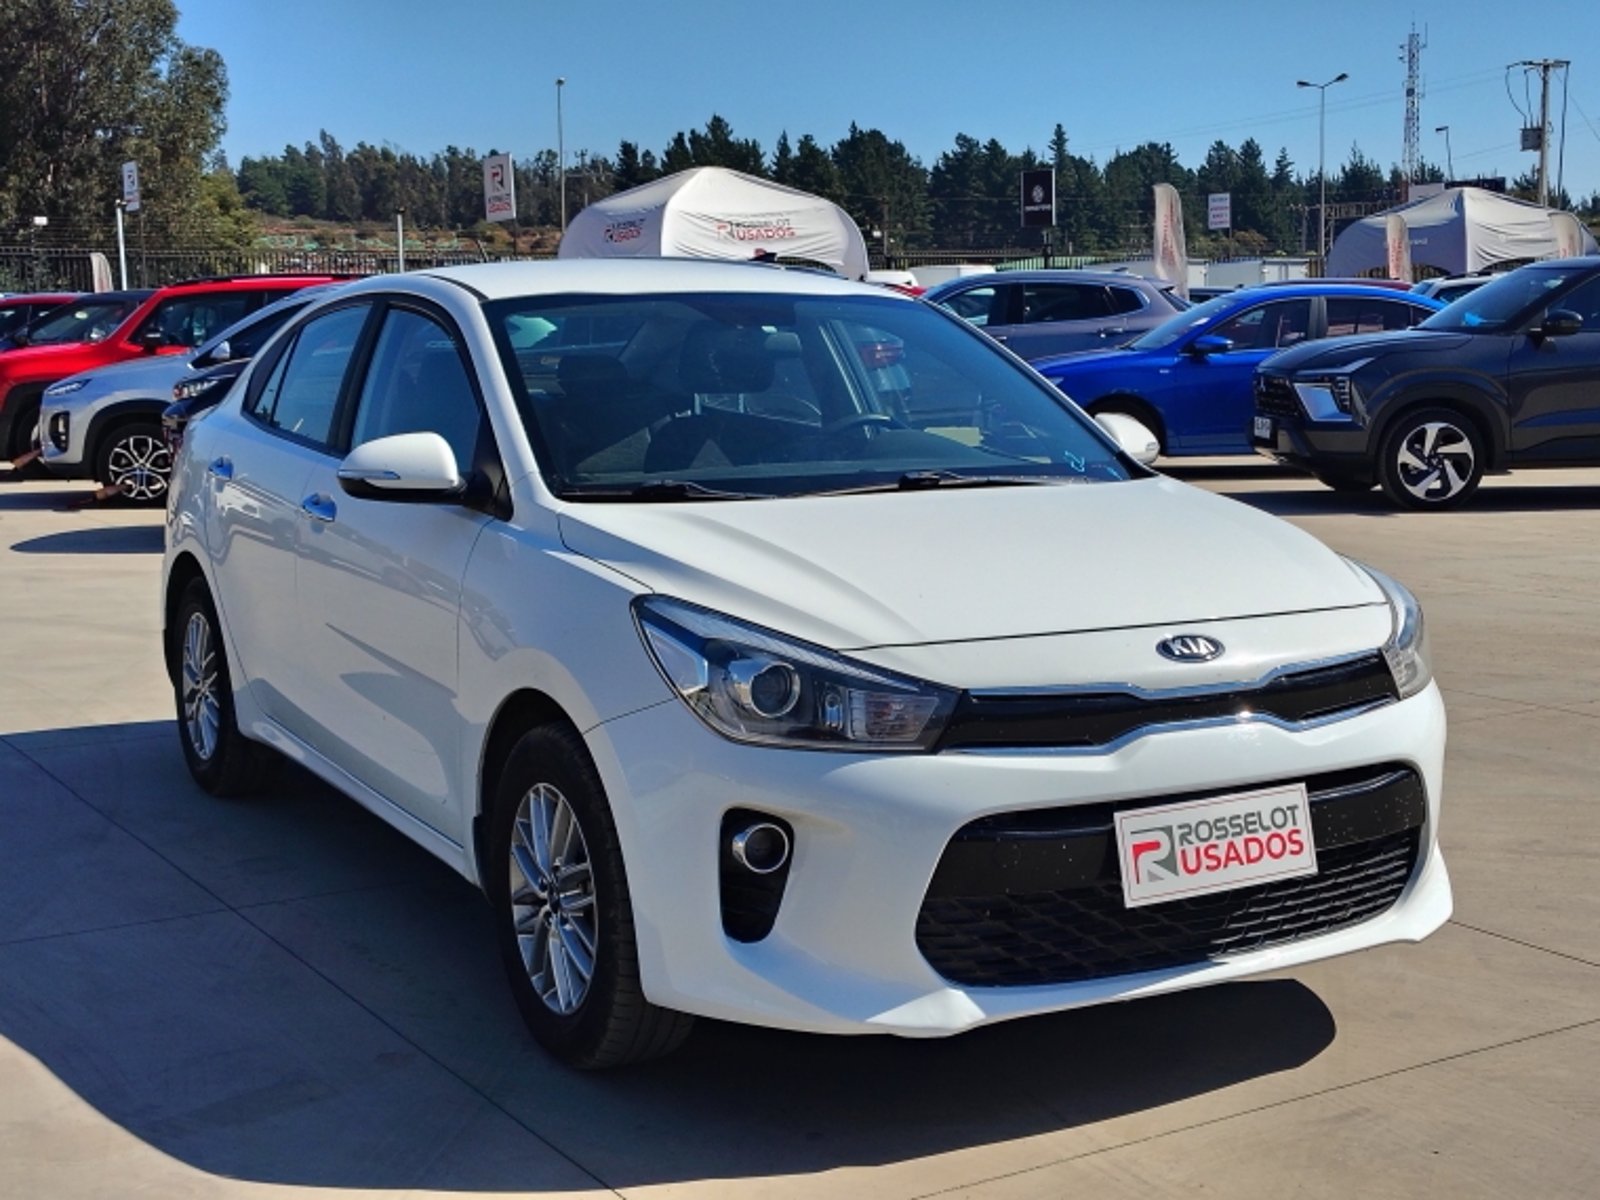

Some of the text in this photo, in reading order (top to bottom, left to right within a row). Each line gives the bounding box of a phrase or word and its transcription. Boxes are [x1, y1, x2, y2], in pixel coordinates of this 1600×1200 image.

[736, 226, 796, 241] USADOS
[1166, 637, 1216, 656] KIA
[1177, 804, 1299, 846] ROSSELOT
[1180, 828, 1304, 876] USADOS
